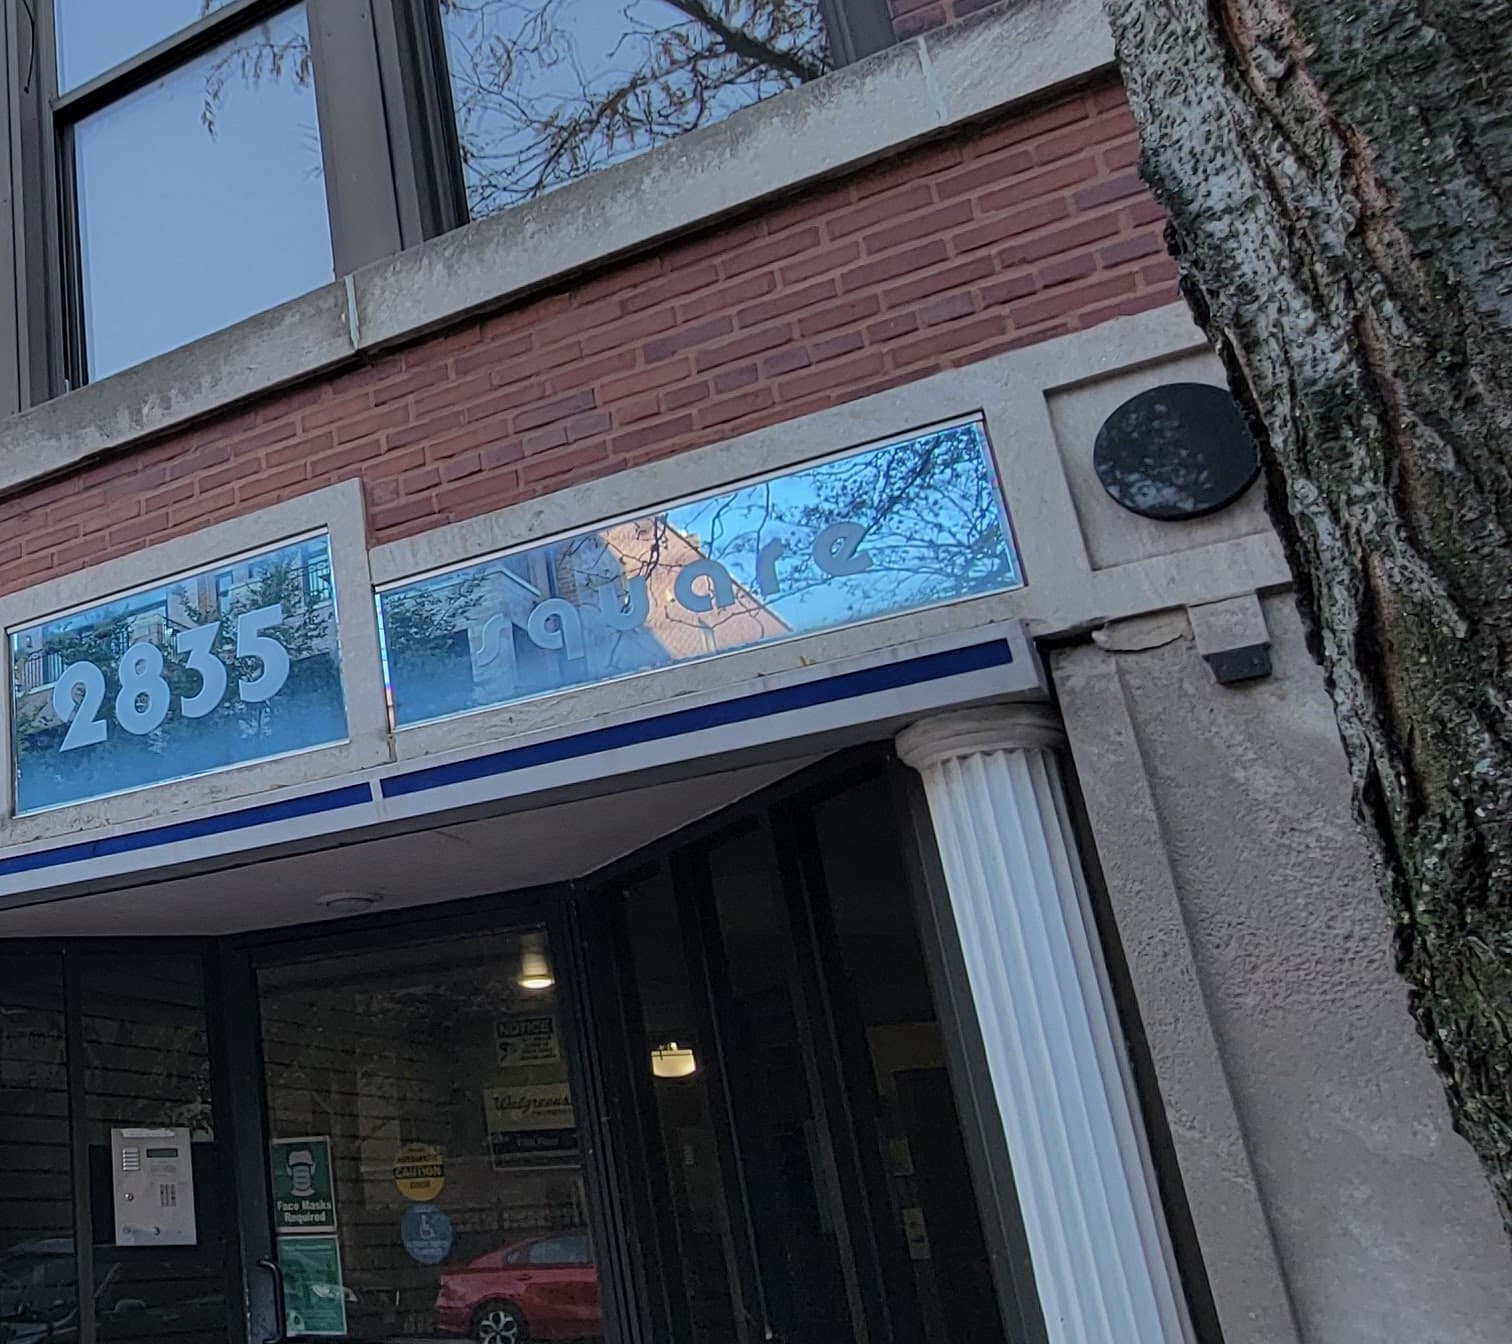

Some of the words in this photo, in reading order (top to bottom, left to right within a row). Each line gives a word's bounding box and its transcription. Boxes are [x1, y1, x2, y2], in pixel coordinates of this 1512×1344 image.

[471, 521, 874, 666] square
[52, 603, 291, 752] 2835
[277, 1200, 300, 1211] Face
[301, 1199, 332, 1210] Masks
[284, 1210, 326, 1224] Required
